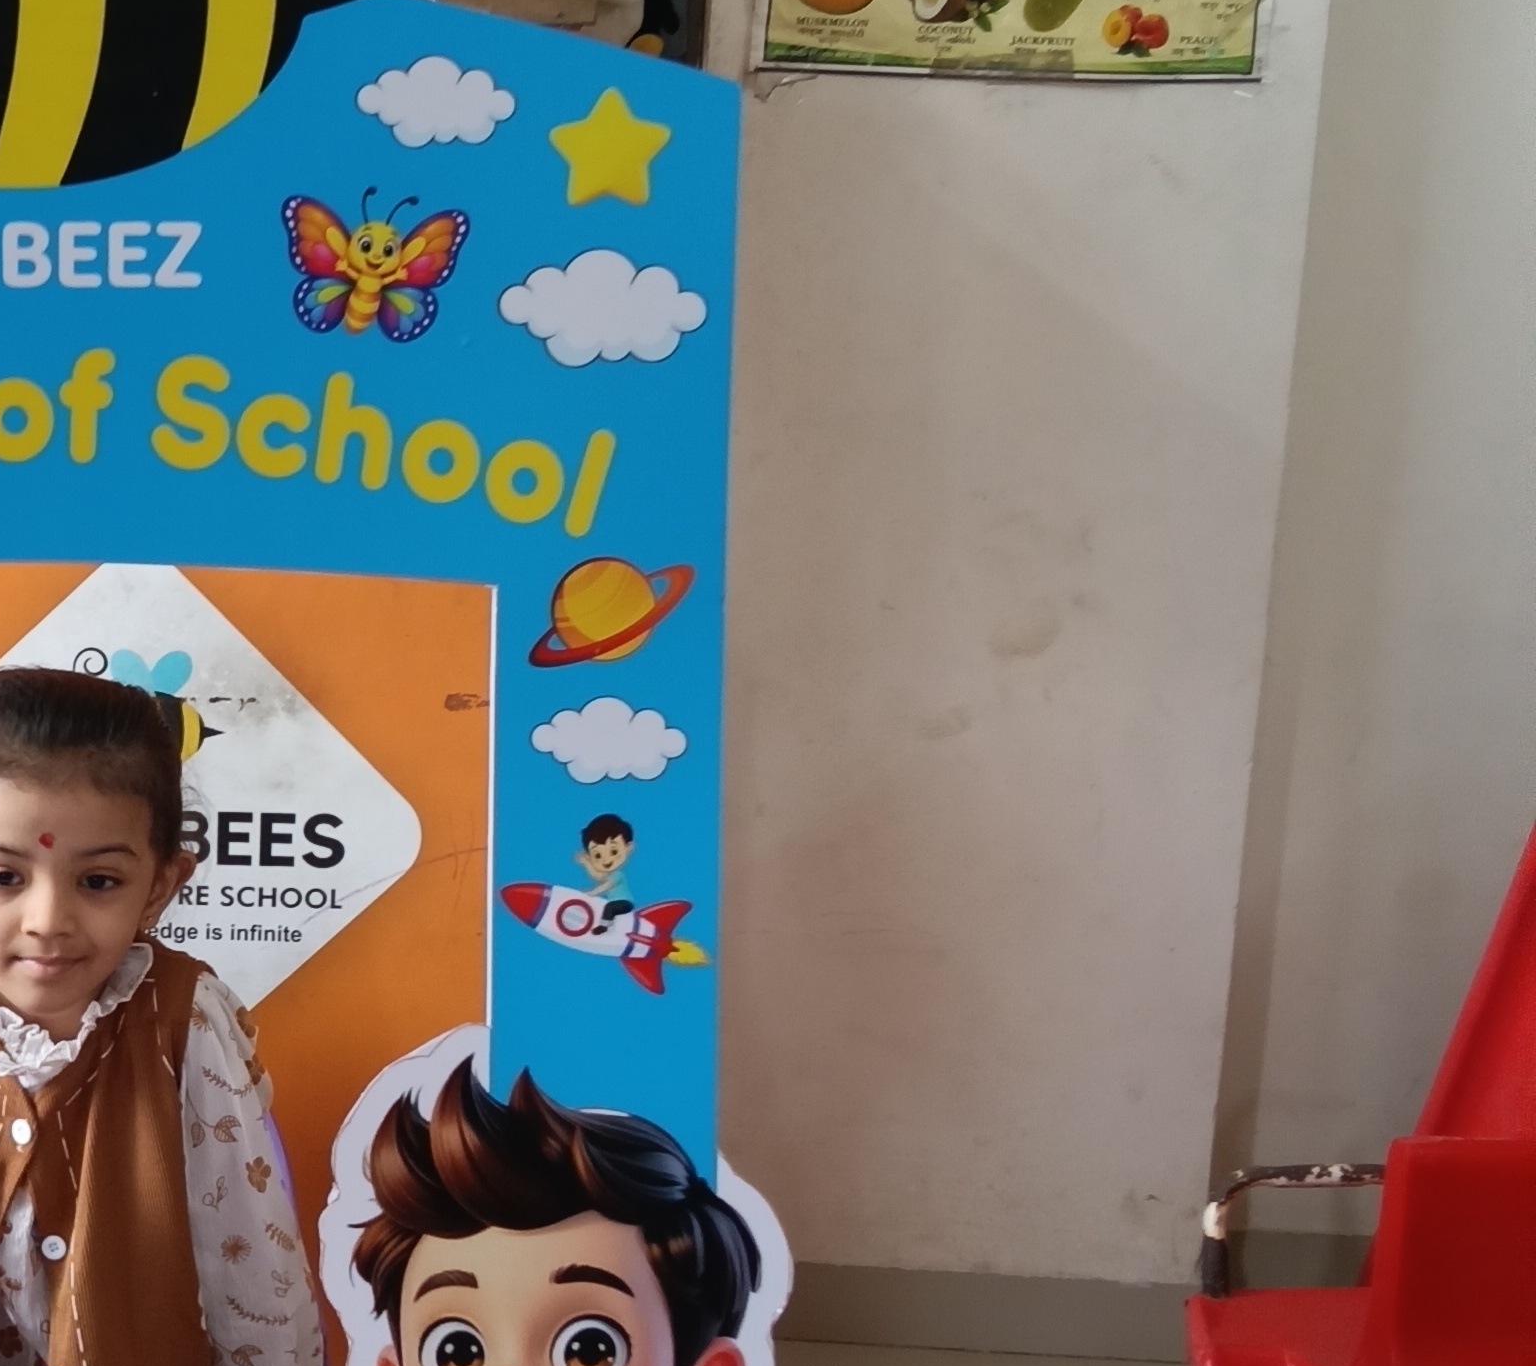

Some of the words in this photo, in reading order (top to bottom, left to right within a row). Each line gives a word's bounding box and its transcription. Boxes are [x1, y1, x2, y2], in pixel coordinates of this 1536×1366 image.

[796, 16, 870, 28] MUSKMELON
[917, 24, 975, 35] COCONUT
[1009, 35, 1076, 46] JACKFRUIT
[1, 220, 203, 289] BEEZ
[150, 353, 617, 538] School
[180, 810, 346, 869] BEES
[177, 885, 210, 906] RE
[219, 886, 344, 910] SCHOOL
[148, 923, 198, 944] edge
[205, 923, 223, 940] is
[230, 924, 303, 943] infinite
